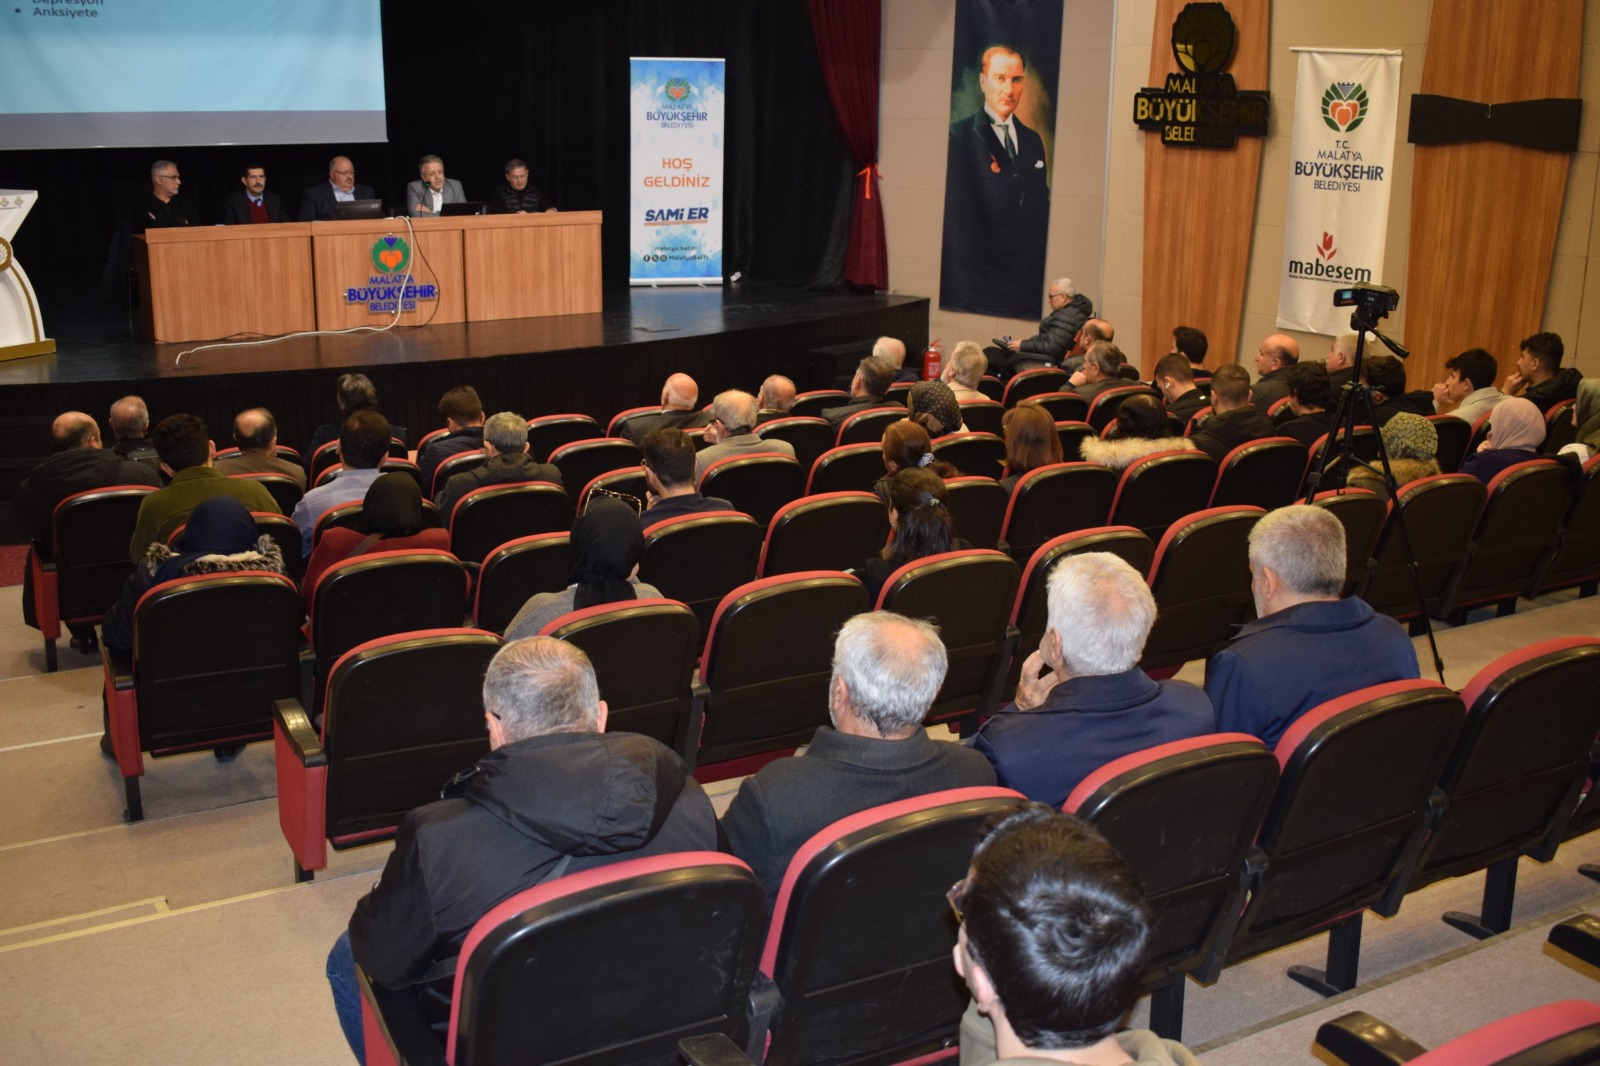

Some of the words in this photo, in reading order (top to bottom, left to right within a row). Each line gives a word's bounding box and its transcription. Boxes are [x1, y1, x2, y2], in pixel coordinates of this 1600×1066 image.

[33, 7, 98, 19] Anksiyete
[1335, 140, 1350, 149] T.C.
[1317, 150, 1362, 161] MALATYA
[662, 158, 692, 172] HOŞ
[643, 174, 710, 187] GELDİNİZ
[687, 207, 709, 220] ER
[1289, 258, 1371, 282] mabesem
